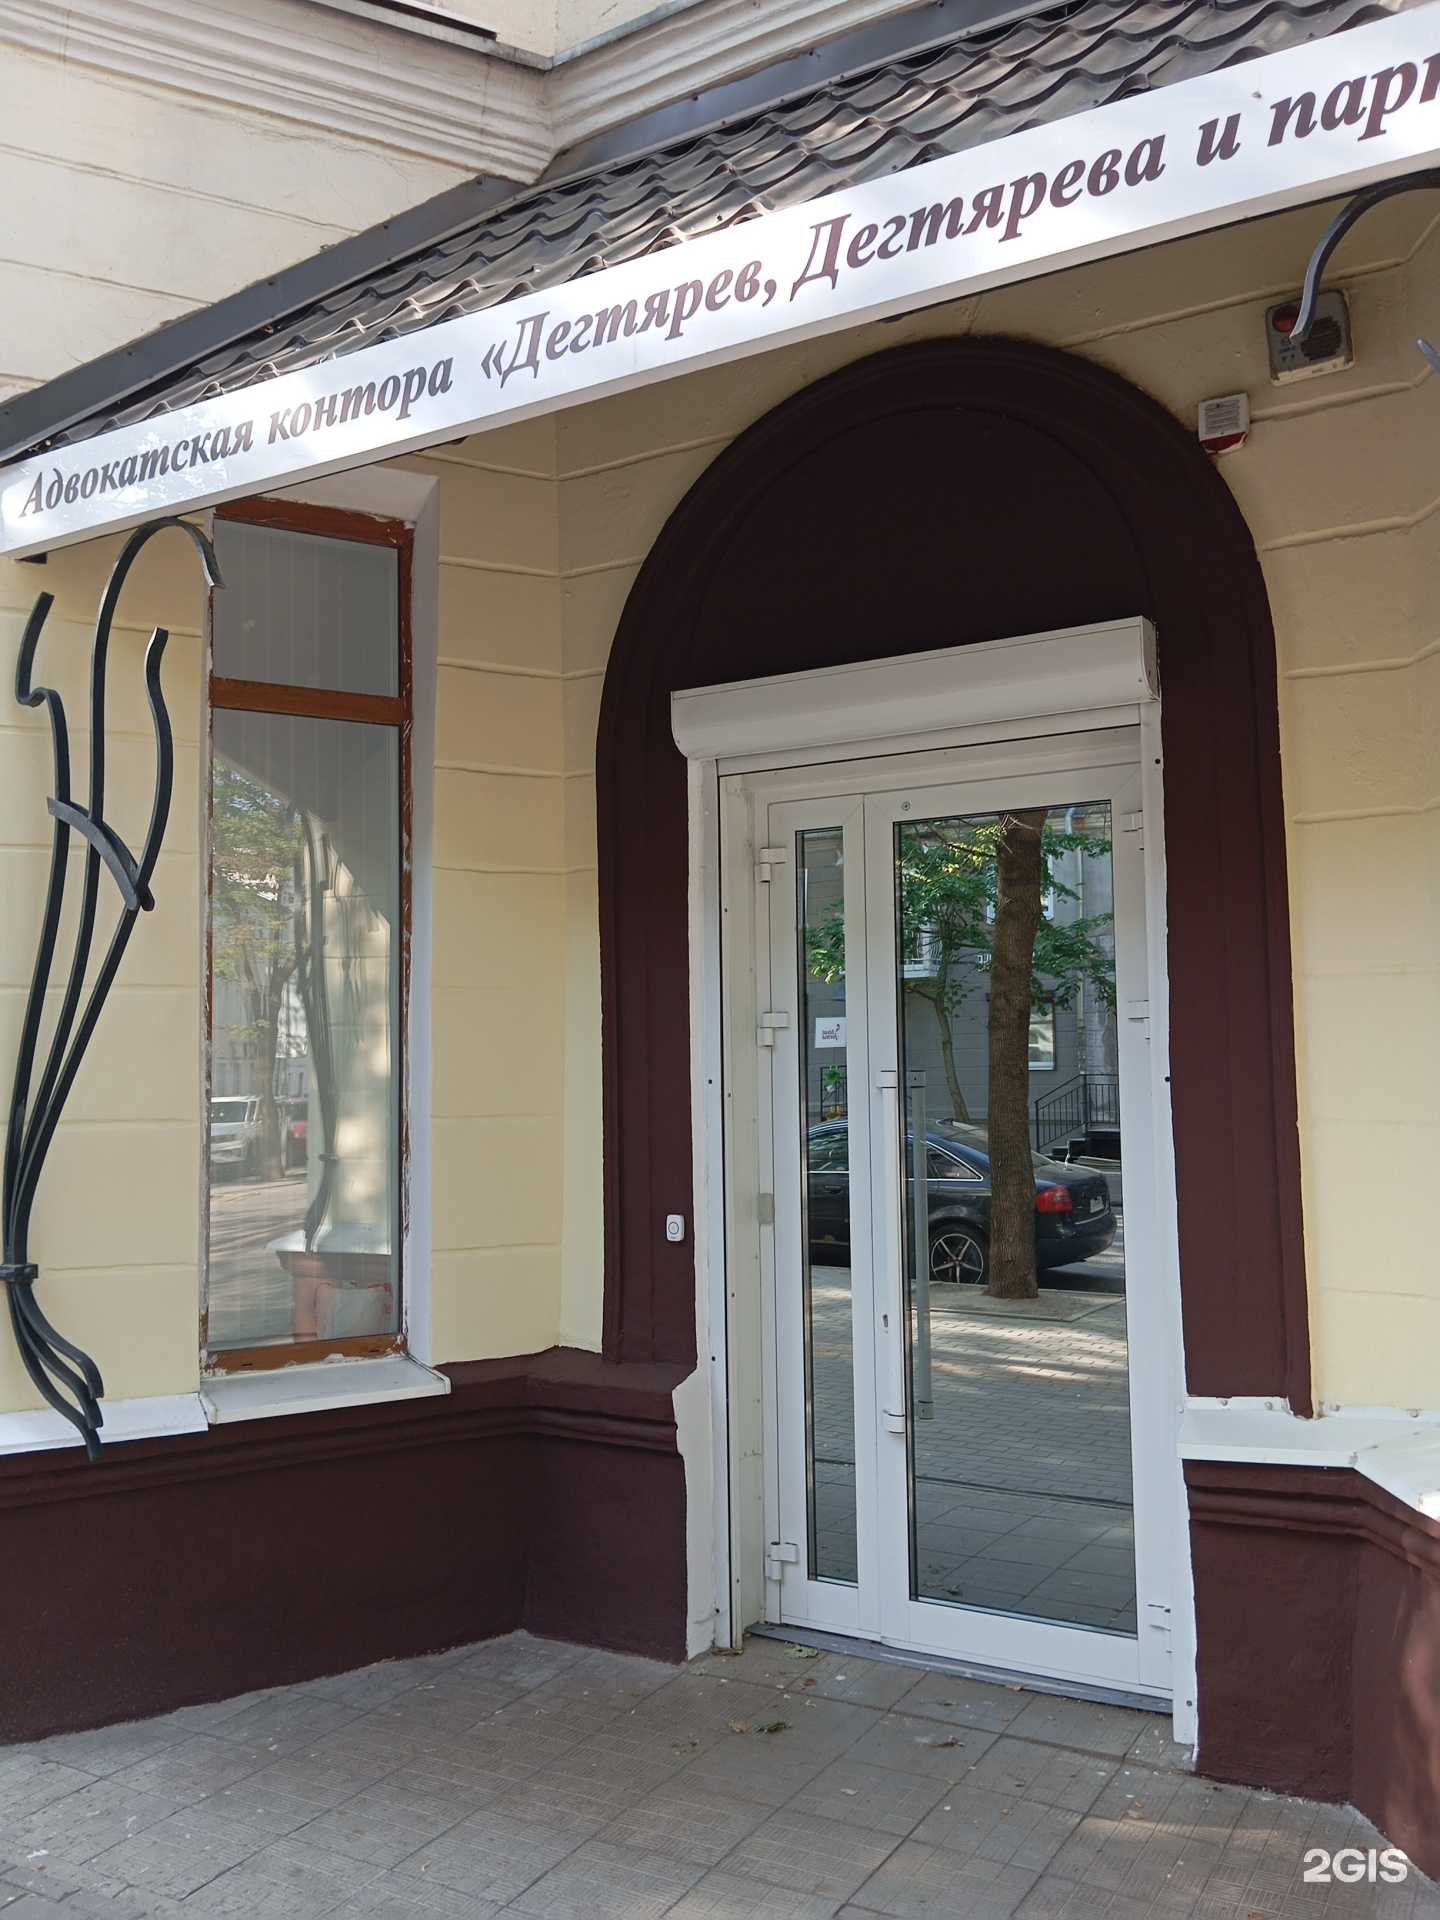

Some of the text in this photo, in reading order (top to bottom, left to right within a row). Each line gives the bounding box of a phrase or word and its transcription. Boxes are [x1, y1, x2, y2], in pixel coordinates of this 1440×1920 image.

[18, 419, 254, 518] Адвокатская
[267, 356, 455, 445] контора
[480, 260, 778, 389] «Дегтярев,
[789, 134, 1166, 302] Дегтярева
[1195, 111, 1242, 167] и
